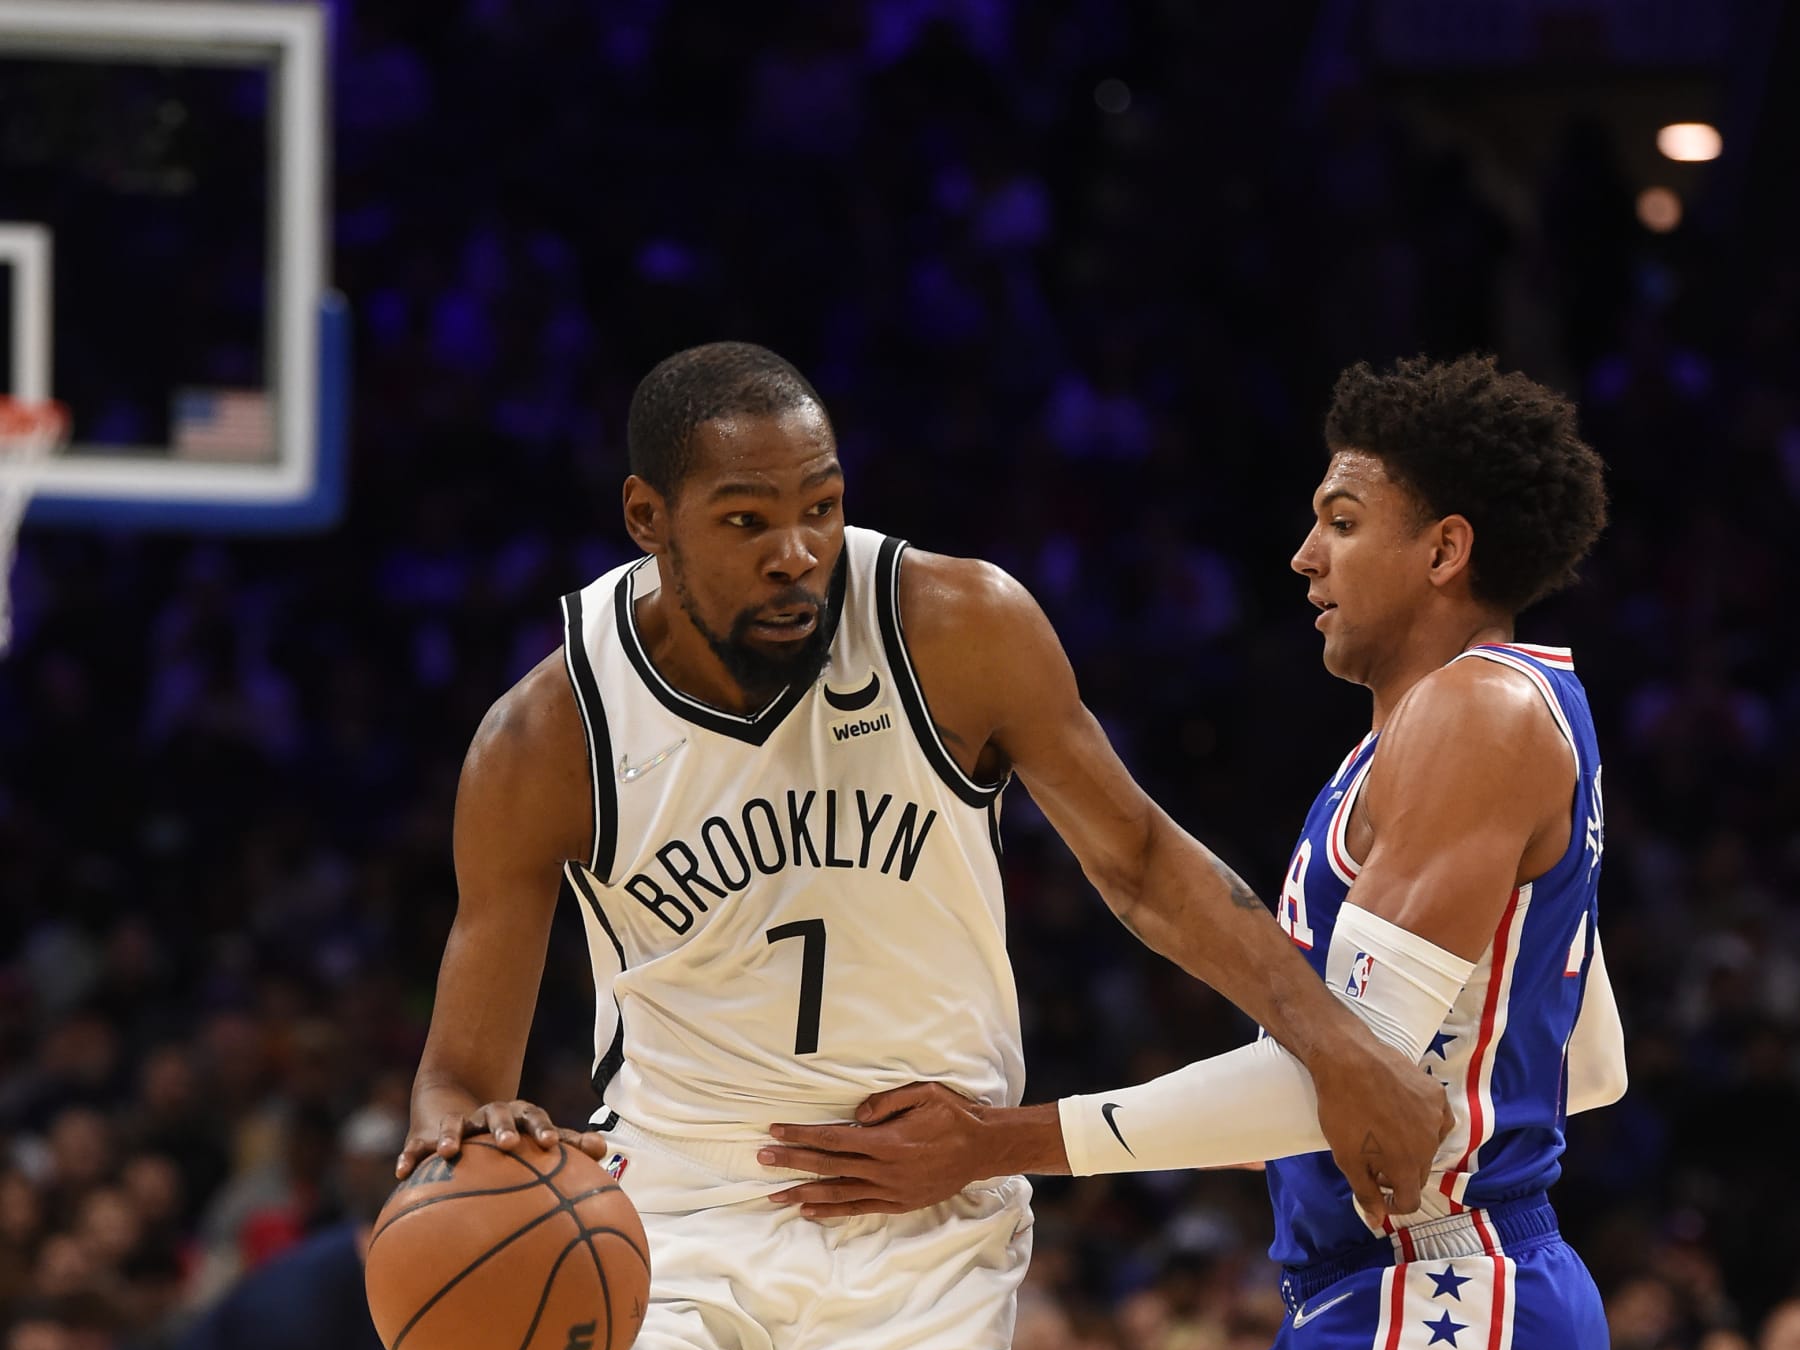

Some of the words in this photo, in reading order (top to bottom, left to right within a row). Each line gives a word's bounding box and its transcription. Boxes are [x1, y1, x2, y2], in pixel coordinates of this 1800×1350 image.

[832, 713, 891, 741] Webull
[624, 789, 937, 936] BROOKLYN
[766, 918, 827, 1055] 7
